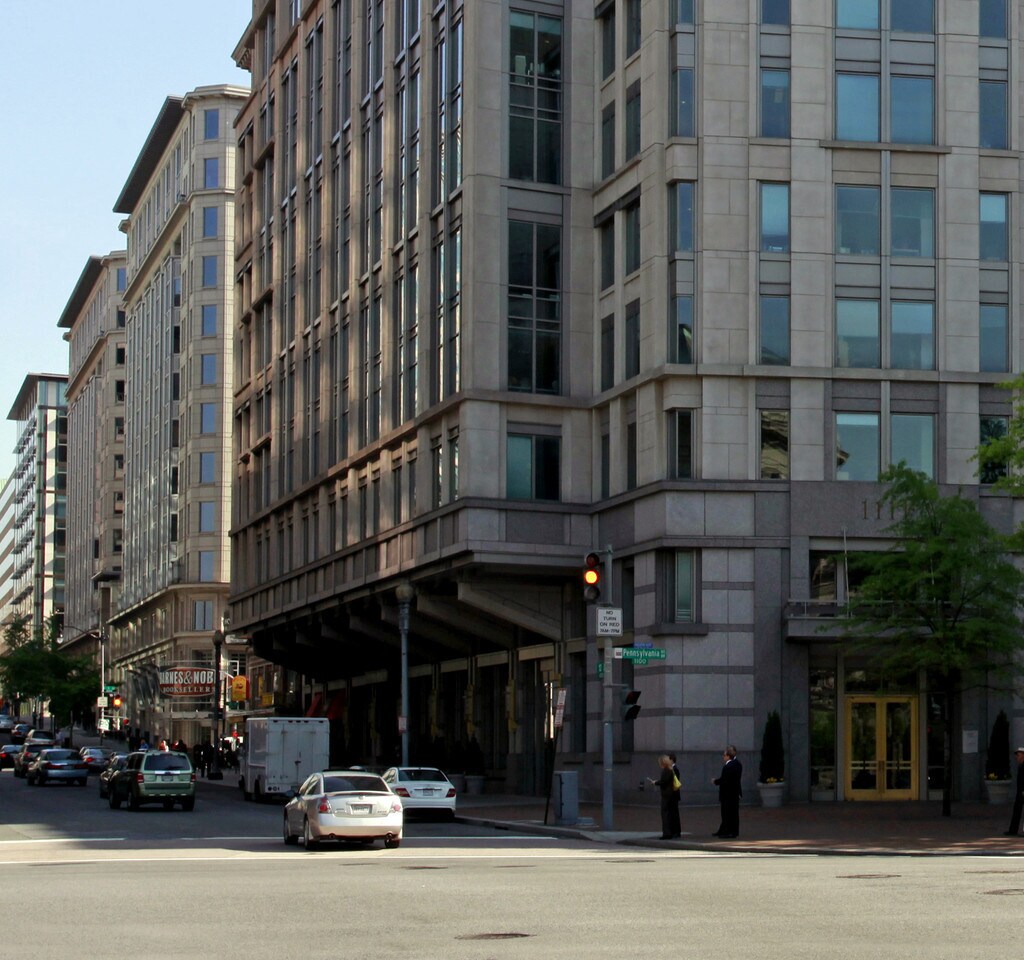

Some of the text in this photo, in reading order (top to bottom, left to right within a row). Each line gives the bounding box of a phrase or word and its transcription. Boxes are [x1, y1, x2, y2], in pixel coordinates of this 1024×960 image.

[623, 649, 660, 658] Pennsylvania
[160, 671, 184, 684] ARNES
[184, 671, 193, 684] &
